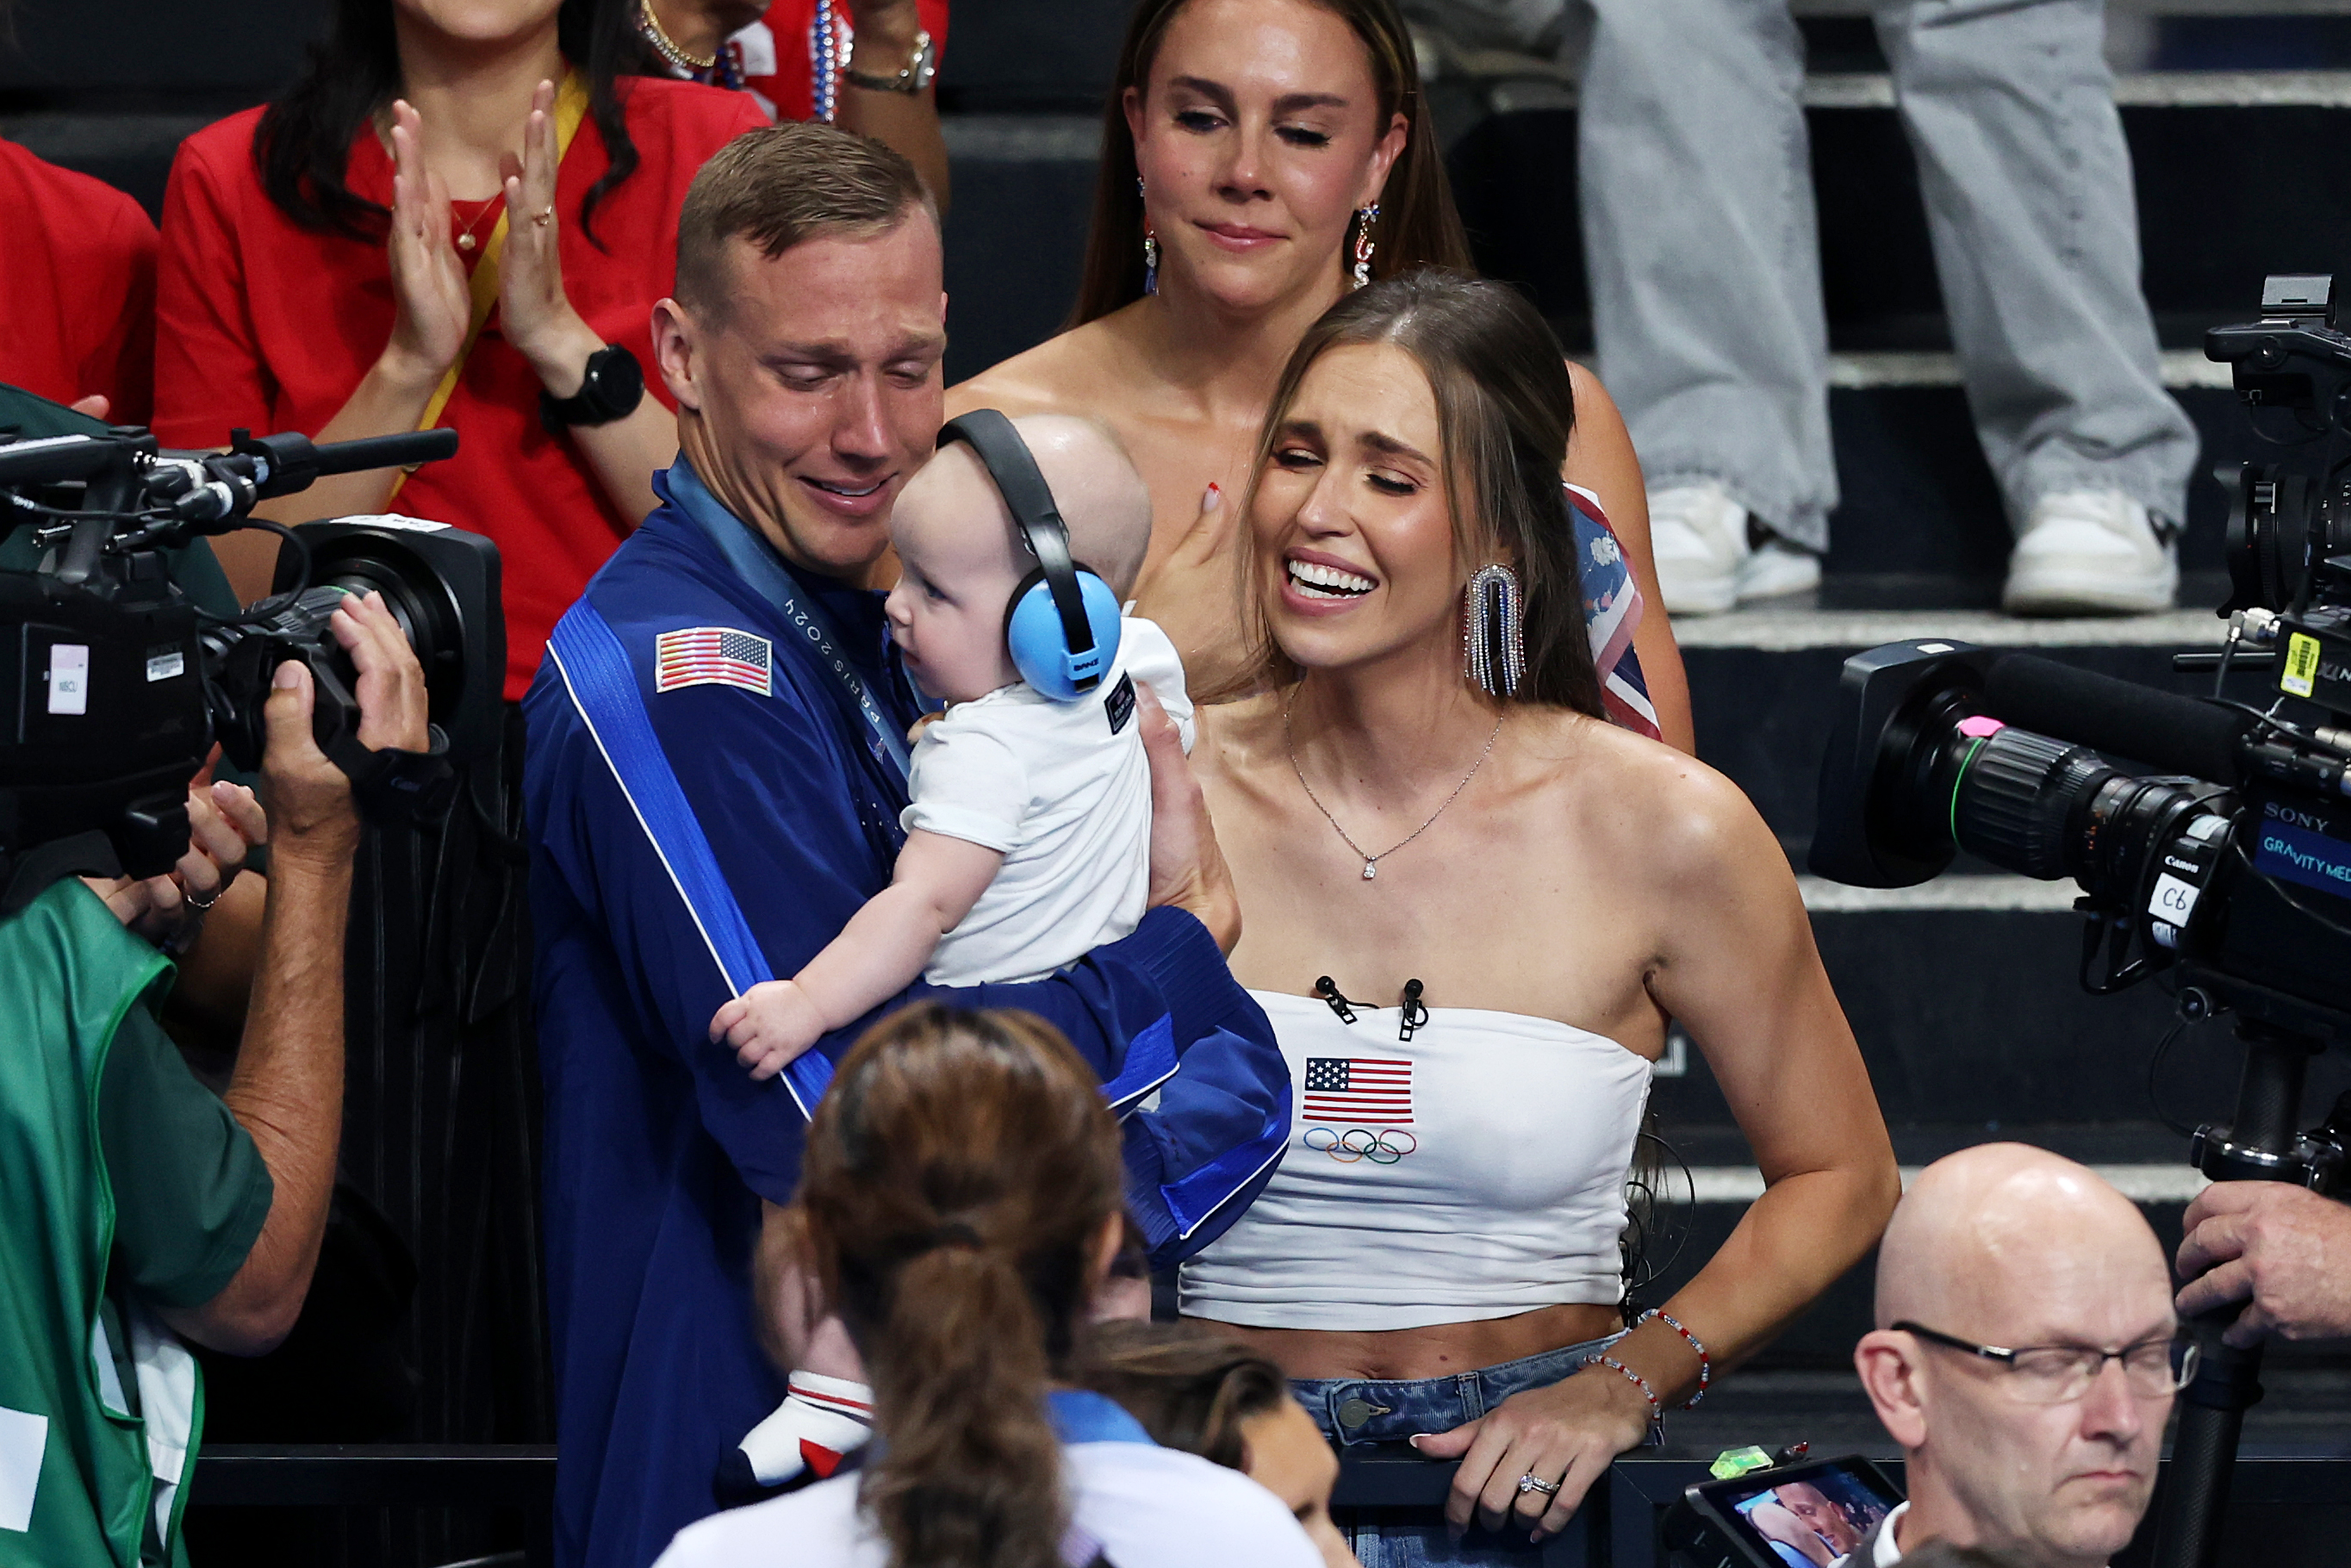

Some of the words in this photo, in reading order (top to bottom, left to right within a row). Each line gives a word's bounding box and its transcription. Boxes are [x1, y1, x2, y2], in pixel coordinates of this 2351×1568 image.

[785, 599, 833, 656] 2024
[834, 659, 880, 724] PARIS
[2264, 801, 2329, 832] SONY
[2165, 855, 2199, 874] Canon
[2264, 837, 2327, 874] GRAVITY
[2163, 887, 2186, 911] C6
